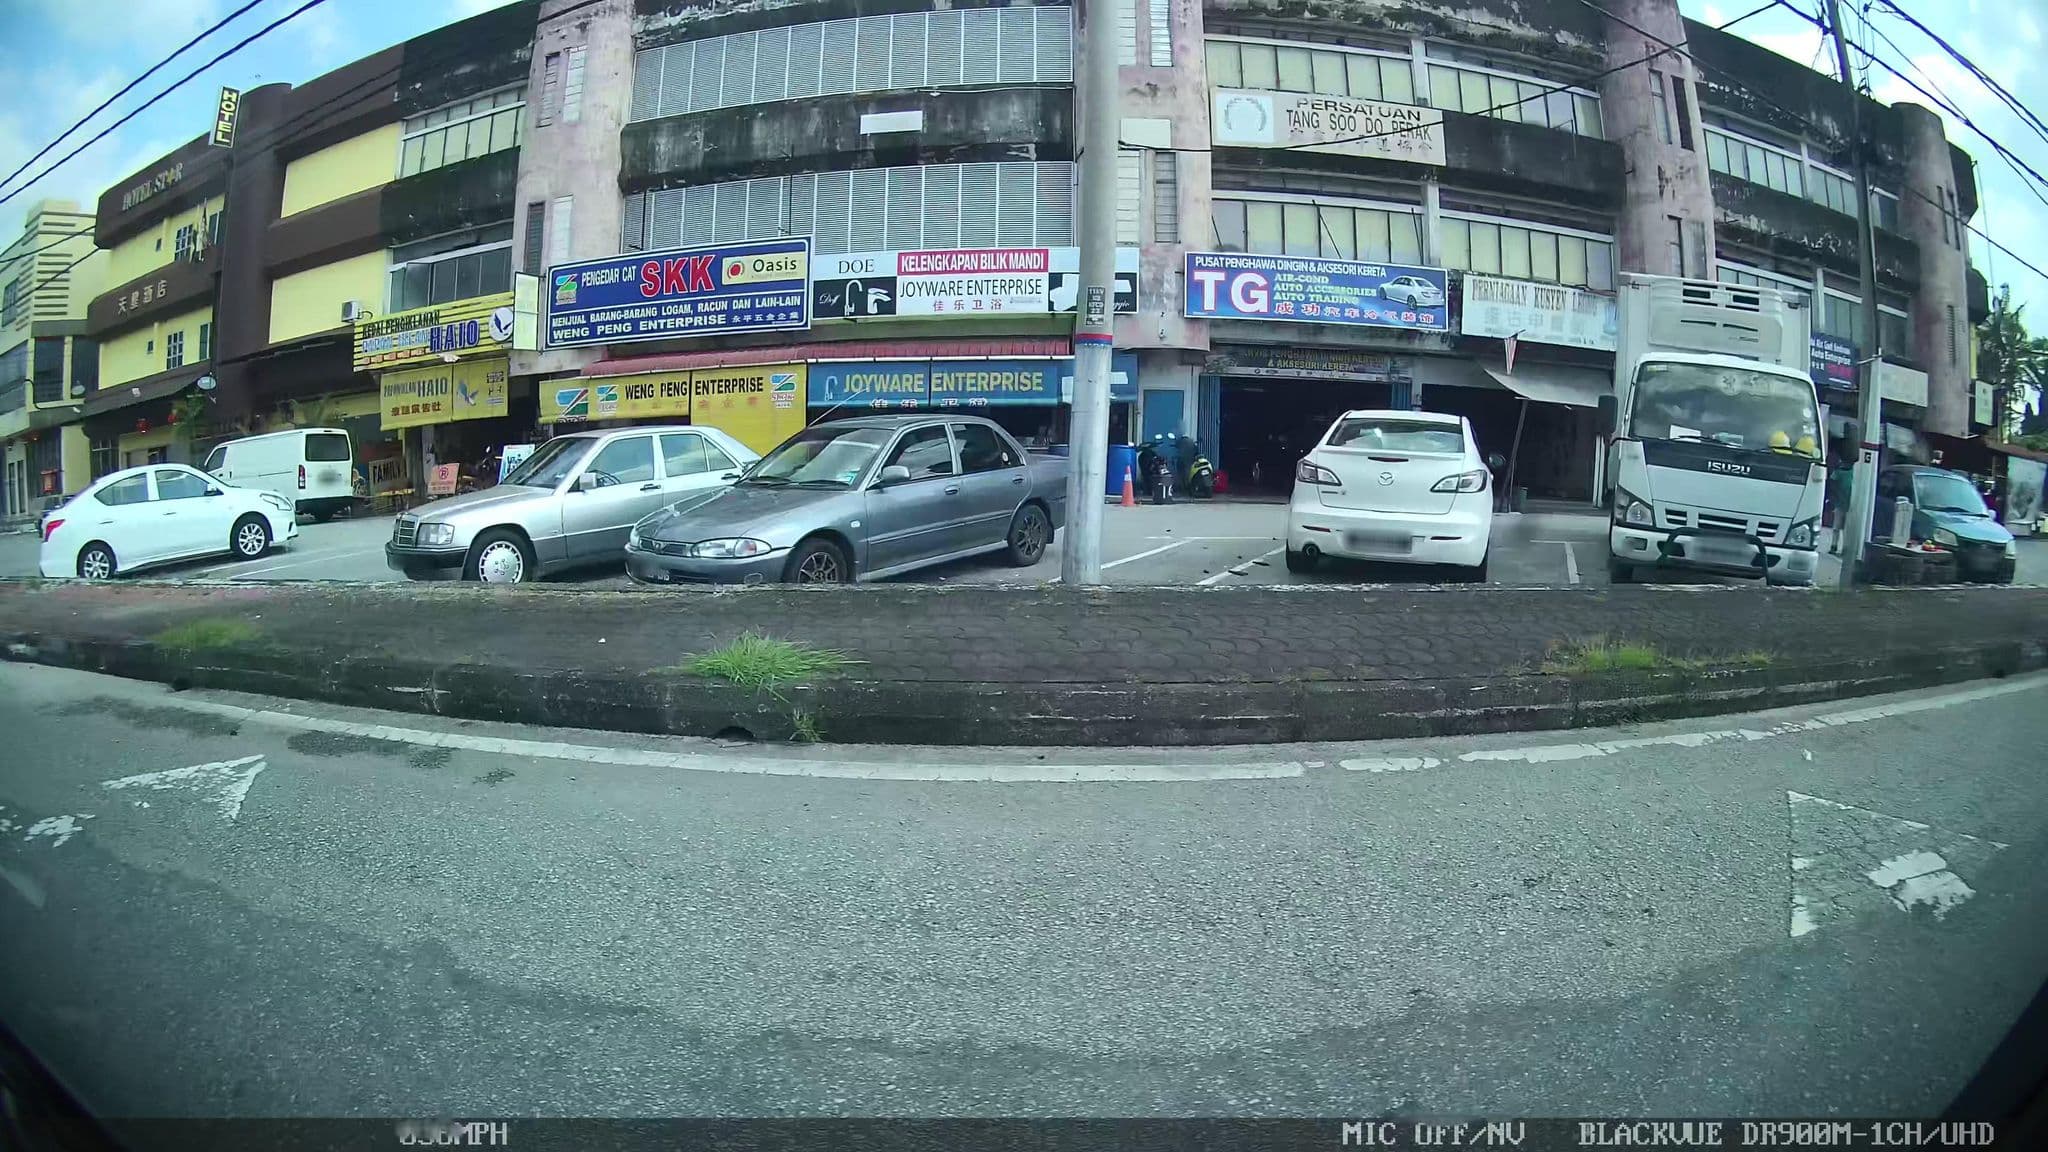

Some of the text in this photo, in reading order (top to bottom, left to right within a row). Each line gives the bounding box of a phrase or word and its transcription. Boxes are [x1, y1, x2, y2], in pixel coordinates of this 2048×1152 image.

[215, 89, 238, 143] HOTEL
[1297, 99, 1421, 121] PERSATUAN
[1286, 109, 1320, 129] TANG
[1329, 114, 1357, 132] SOO
[1365, 118, 1383, 135] DO
[1392, 120, 1432, 141] PERAK
[753, 256, 797, 272] Oasis
[838, 259, 875, 274] DOE
[901, 251, 1044, 273] KELENGKAPAN BILIK MANDI
[1195, 256, 1387, 278] PUSAT PENGHAWA DINGIN & AKSESORI KERETA
[581, 265, 637, 288] PENGEDAR CAT
[640, 255, 717, 298] SKK
[1274, 273, 1329, 284] AIR-COND
[900, 278, 1042, 298] JOYWARE ENTERPRISE
[1193, 270, 1270, 314] TG
[1273, 284, 1377, 297] AUTO ACCESSORIES
[1273, 292, 1360, 305] AUTO TRADING
[552, 294, 801, 328] MENJUAL BARANG-BARANG LOGAM, RACUN DAN LAIN-LAIN
[430, 320, 480, 352] HAIO
[553, 314, 727, 340] WENG PENG ENTERPRISE
[625, 376, 764, 400] WENG PENG ENTERPRISE
[844, 371, 1043, 393] JOYWARE ENTERPRISE
[1707, 460, 1751, 475] ISUZU
